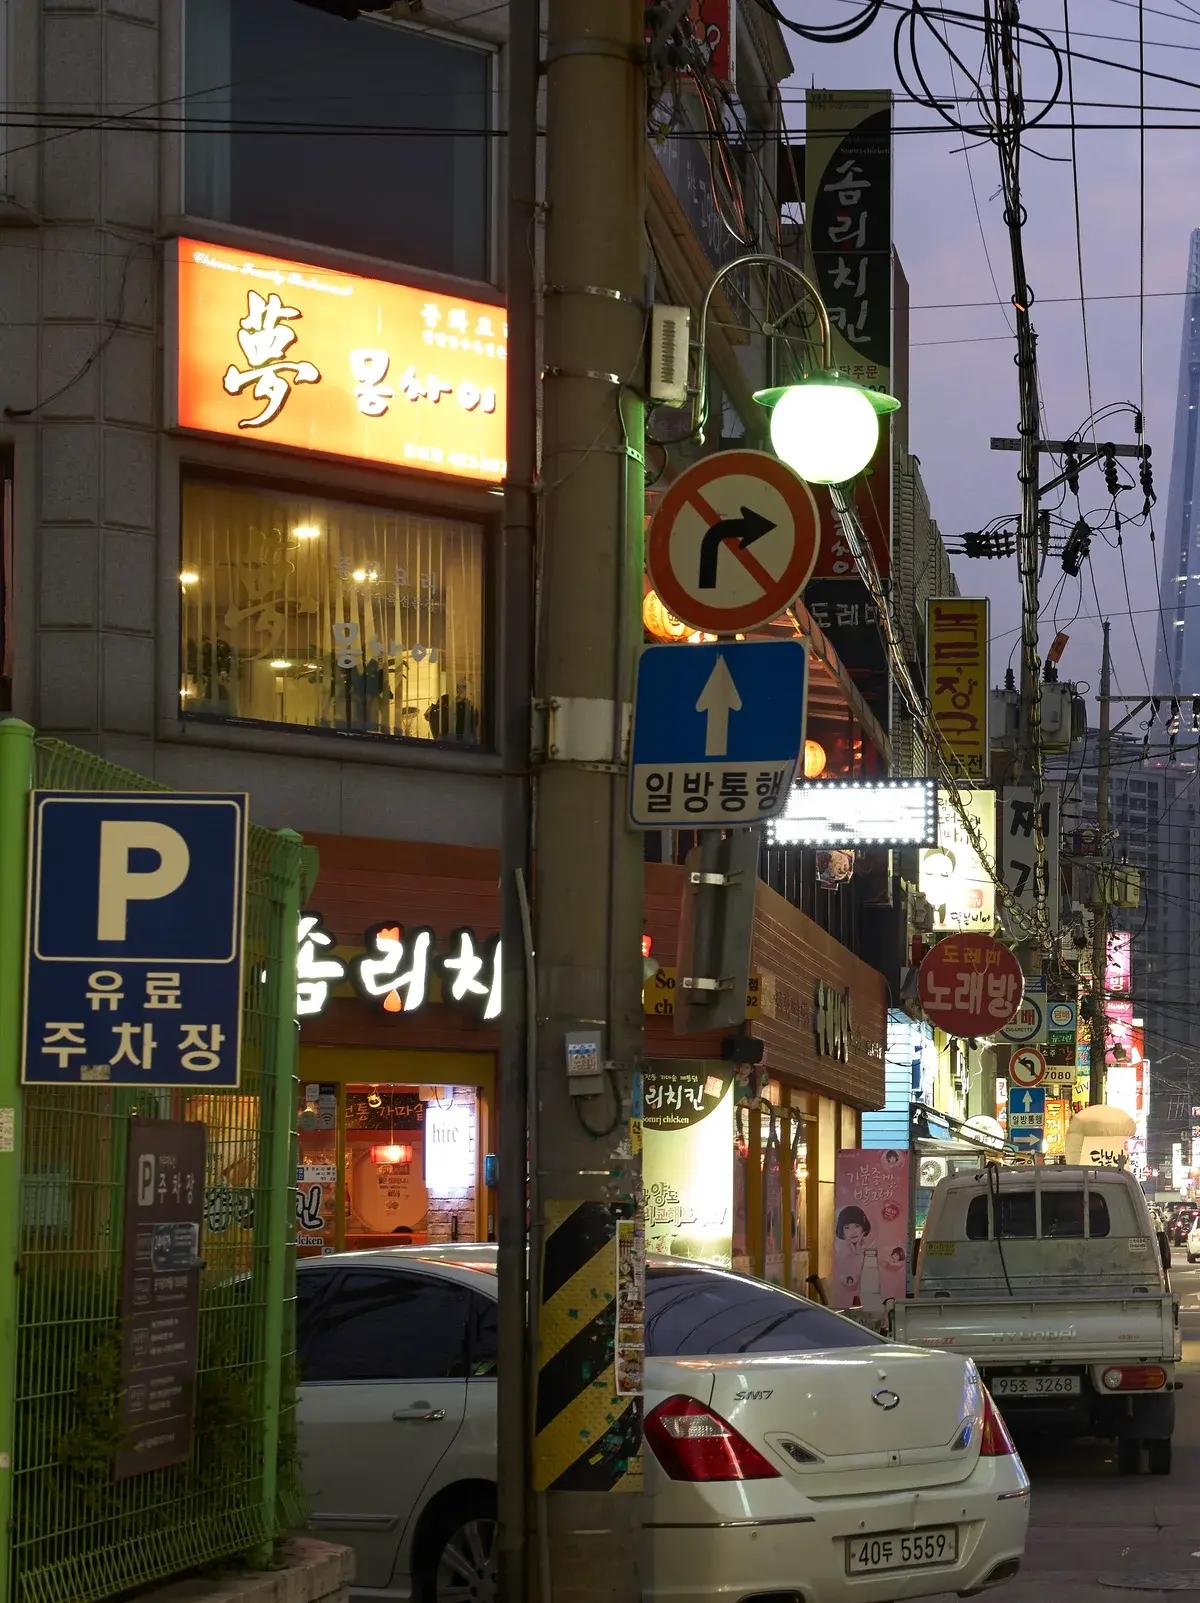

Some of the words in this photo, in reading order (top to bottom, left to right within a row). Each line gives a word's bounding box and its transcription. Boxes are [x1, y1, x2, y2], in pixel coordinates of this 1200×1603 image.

[824, 160, 872, 343] 솜리치킨
[222, 289, 322, 430] 夢
[934, 754, 984, 776] 두전
[646, 770, 785, 813] 일방통행
[97, 819, 190, 942] P
[297, 917, 502, 1019] 솜리치
[942, 945, 1000, 965] 도레미
[86, 970, 183, 1011] 유료
[923, 971, 1017, 1018] 노래방
[41, 1022, 226, 1072] 주차장
[1044, 1072, 1071, 1080] 7080
[1075, 1082, 1090, 1095] LIV
[644, 1084, 705, 1111] 리치킨
[1012, 1115, 1042, 1125] 일방통행
[157, 1172, 195, 1205] 주차장
[847, 1164, 894, 1186] 기분좋게
[734, 1390, 773, 1400] SM7
[999, 1379, 1030, 1393] 95조
[1035, 1378, 1073, 1392] 3268
[858, 1541, 894, 1566] 40두
[901, 1534, 946, 1561] 5559
